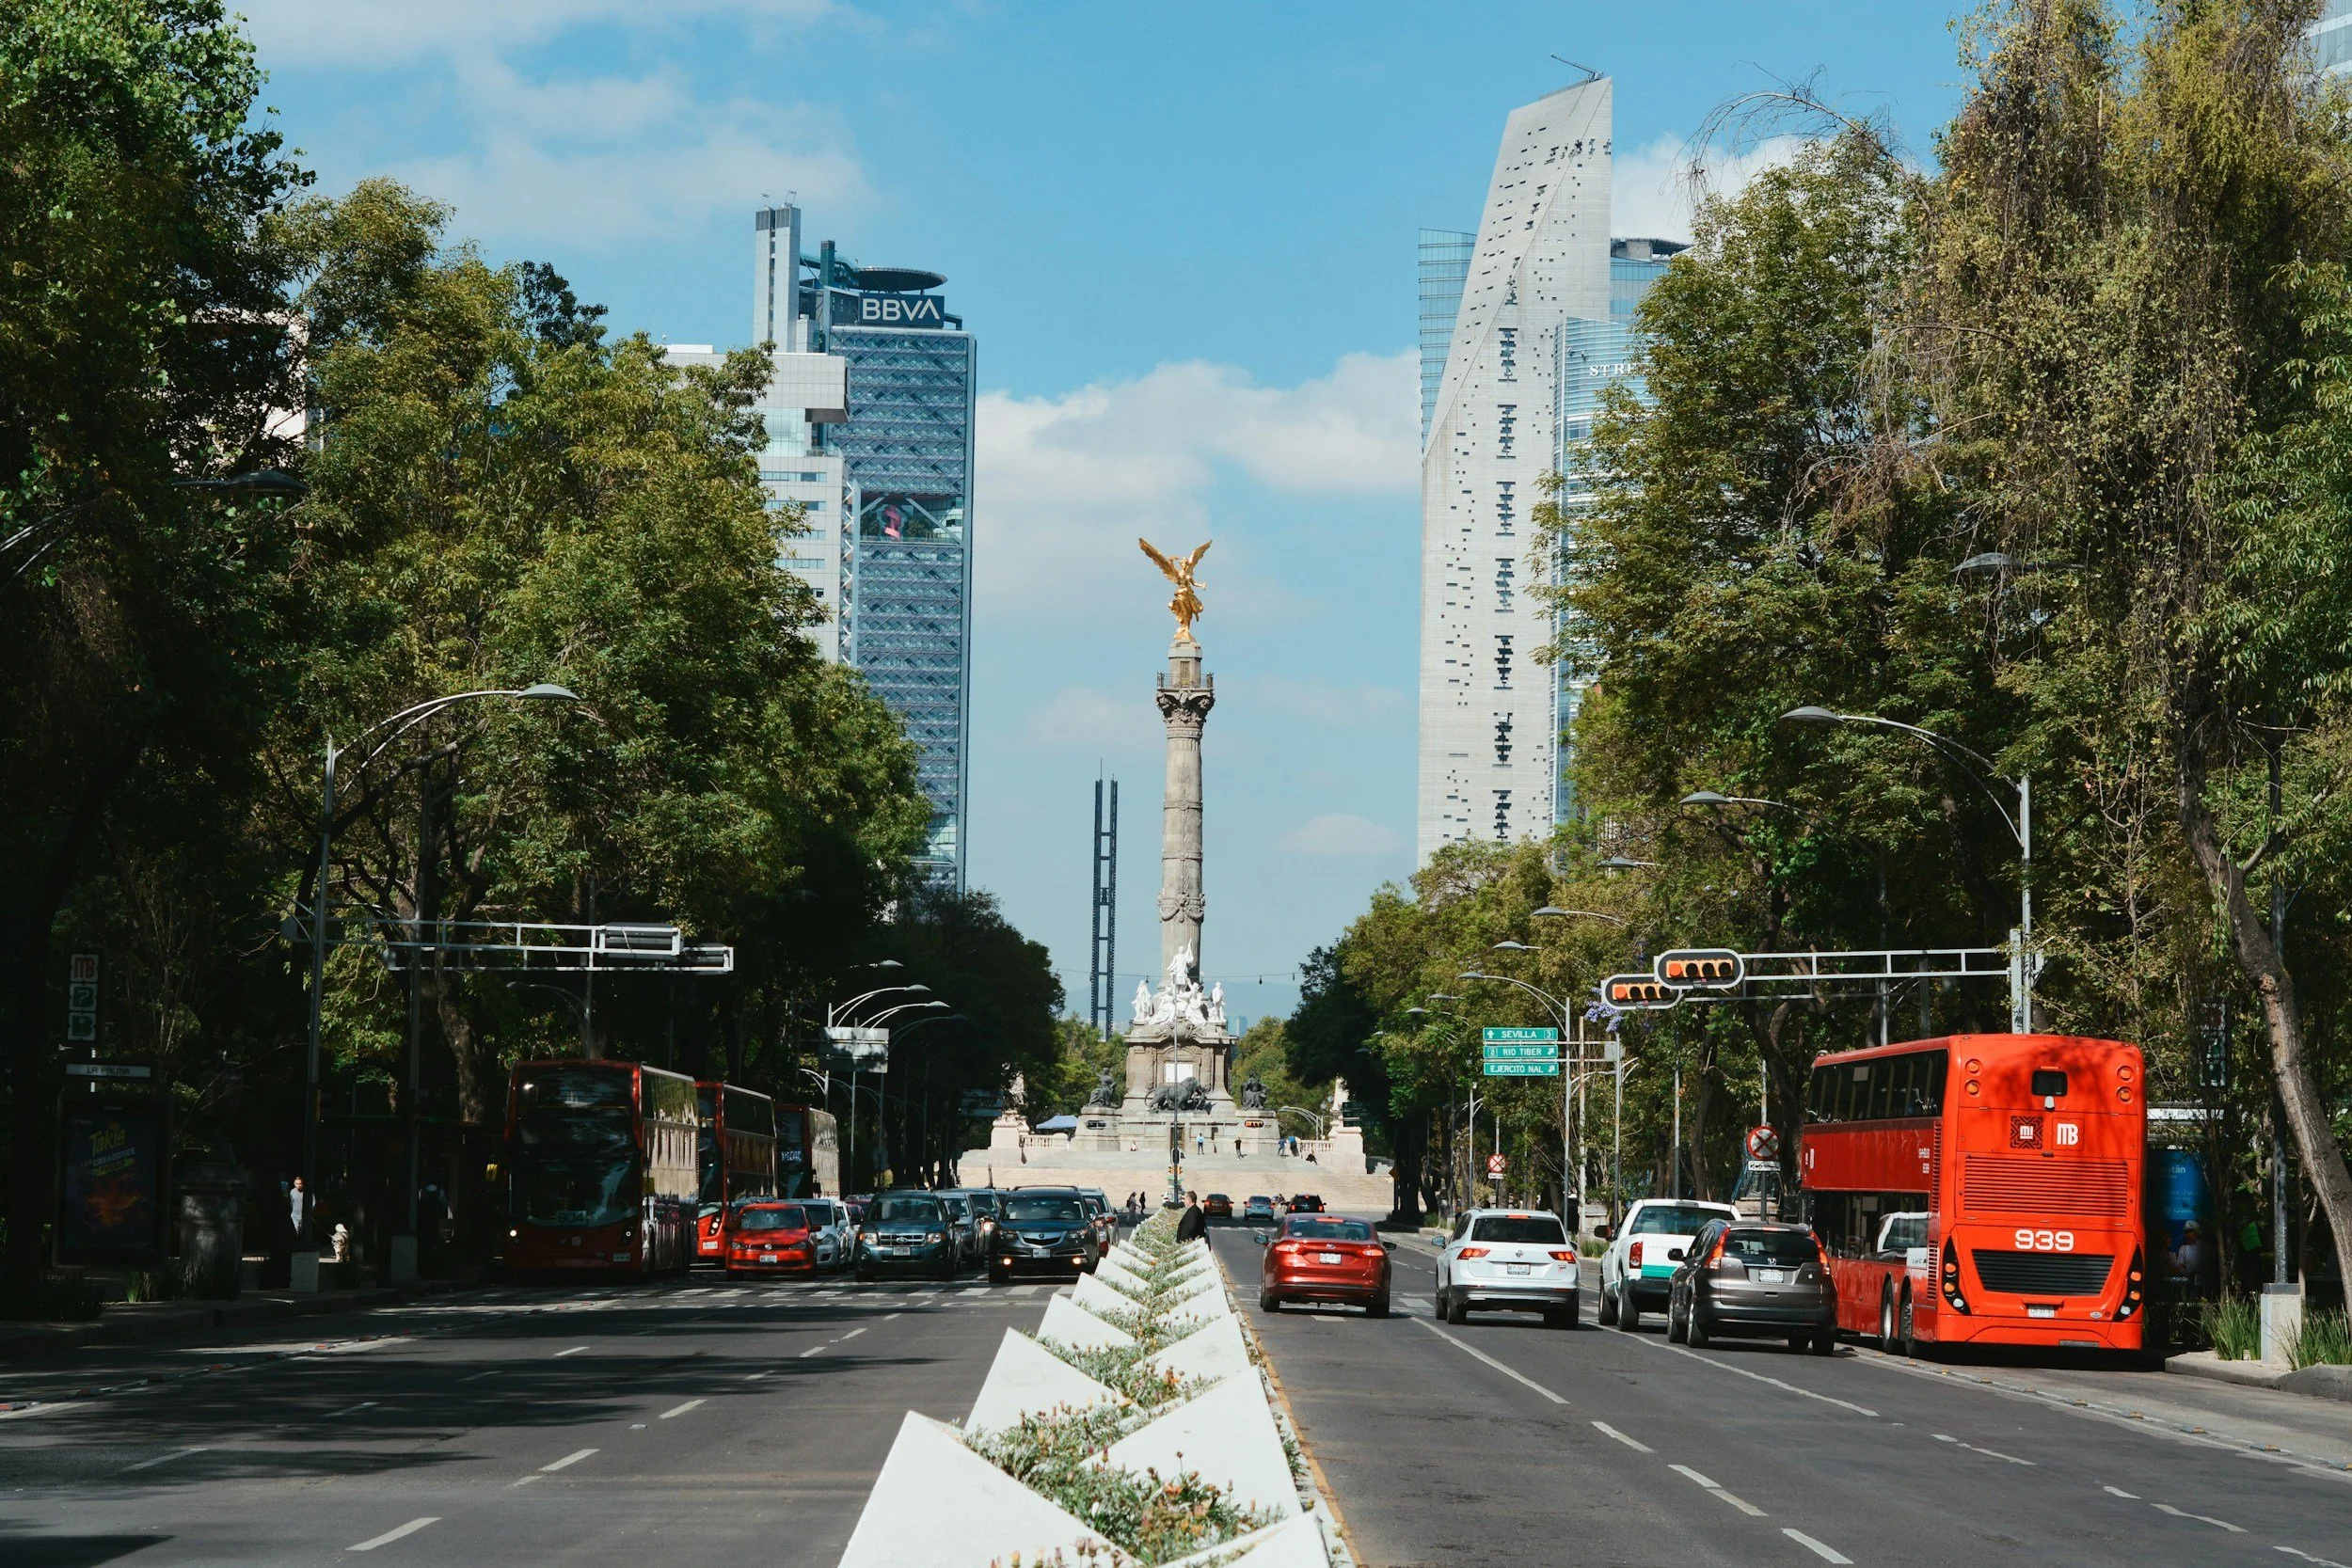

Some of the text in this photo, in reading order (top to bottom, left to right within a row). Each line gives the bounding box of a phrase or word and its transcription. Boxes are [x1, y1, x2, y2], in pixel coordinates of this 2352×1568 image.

[862, 297, 941, 322] BBVA
[1502, 1030, 1537, 1038] SEVILLA
[101, 1067, 131, 1075] PALMA
[1490, 1065, 1544, 1073] EJERCITO NAL
[88, 1128, 126, 1158] Takis
[2057, 1123, 2079, 1146] MB
[2014, 1228, 2075, 1252] 939
